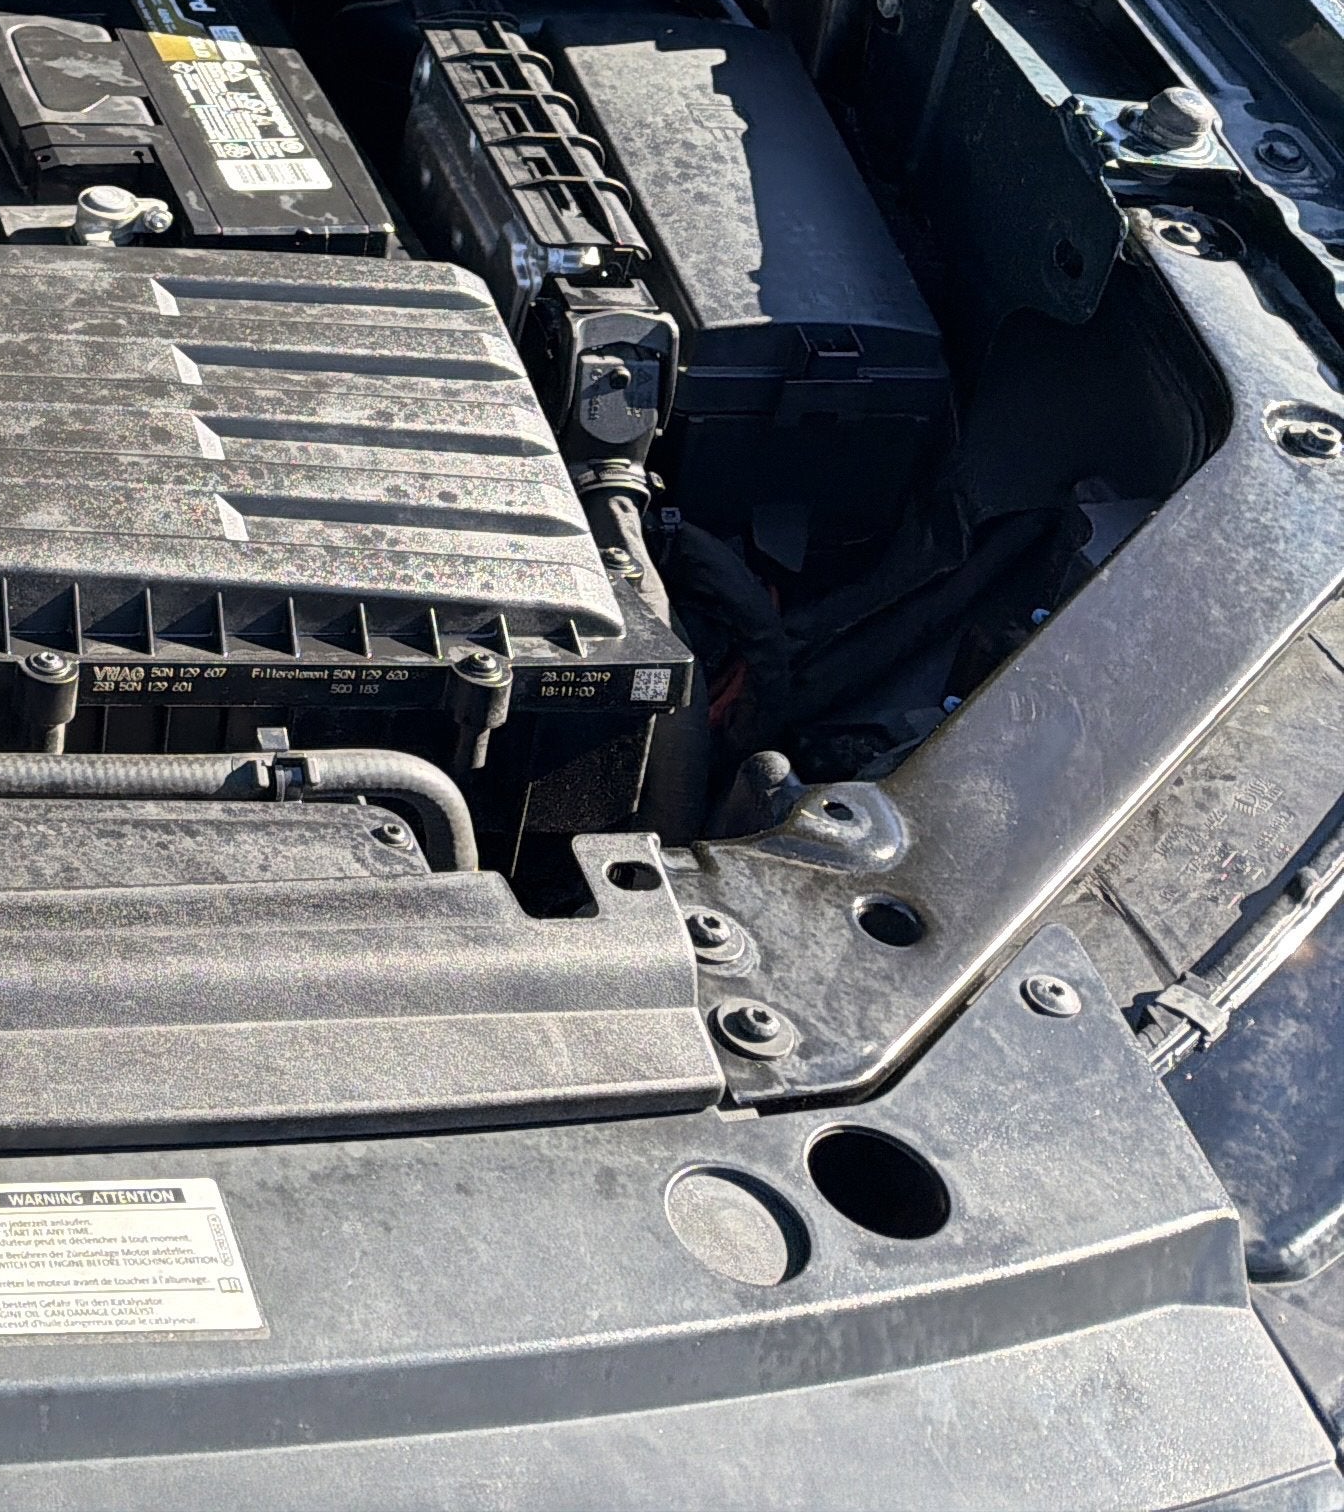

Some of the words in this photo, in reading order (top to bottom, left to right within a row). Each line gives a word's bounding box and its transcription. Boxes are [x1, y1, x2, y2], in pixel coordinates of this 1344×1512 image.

[179, 667, 201, 678] 129
[203, 667, 227, 678] 607
[251, 667, 328, 679] Filterelement
[361, 669, 382, 680] 129
[385, 669, 409, 680] 620
[147, 681, 168, 692] 129
[171, 681, 192, 692] 601
[358, 683, 379, 694] 183
[540, 685, 595, 696] 18:11:00
[7, 1191, 85, 1206] WARNING
[89, 1189, 176, 1204] ATTENTION
[3, 1229, 30, 1237] START
[31, 1228, 44, 1236] AT
[44, 1228, 65, 1236] ANY
[98, 1277, 113, 1286] de
